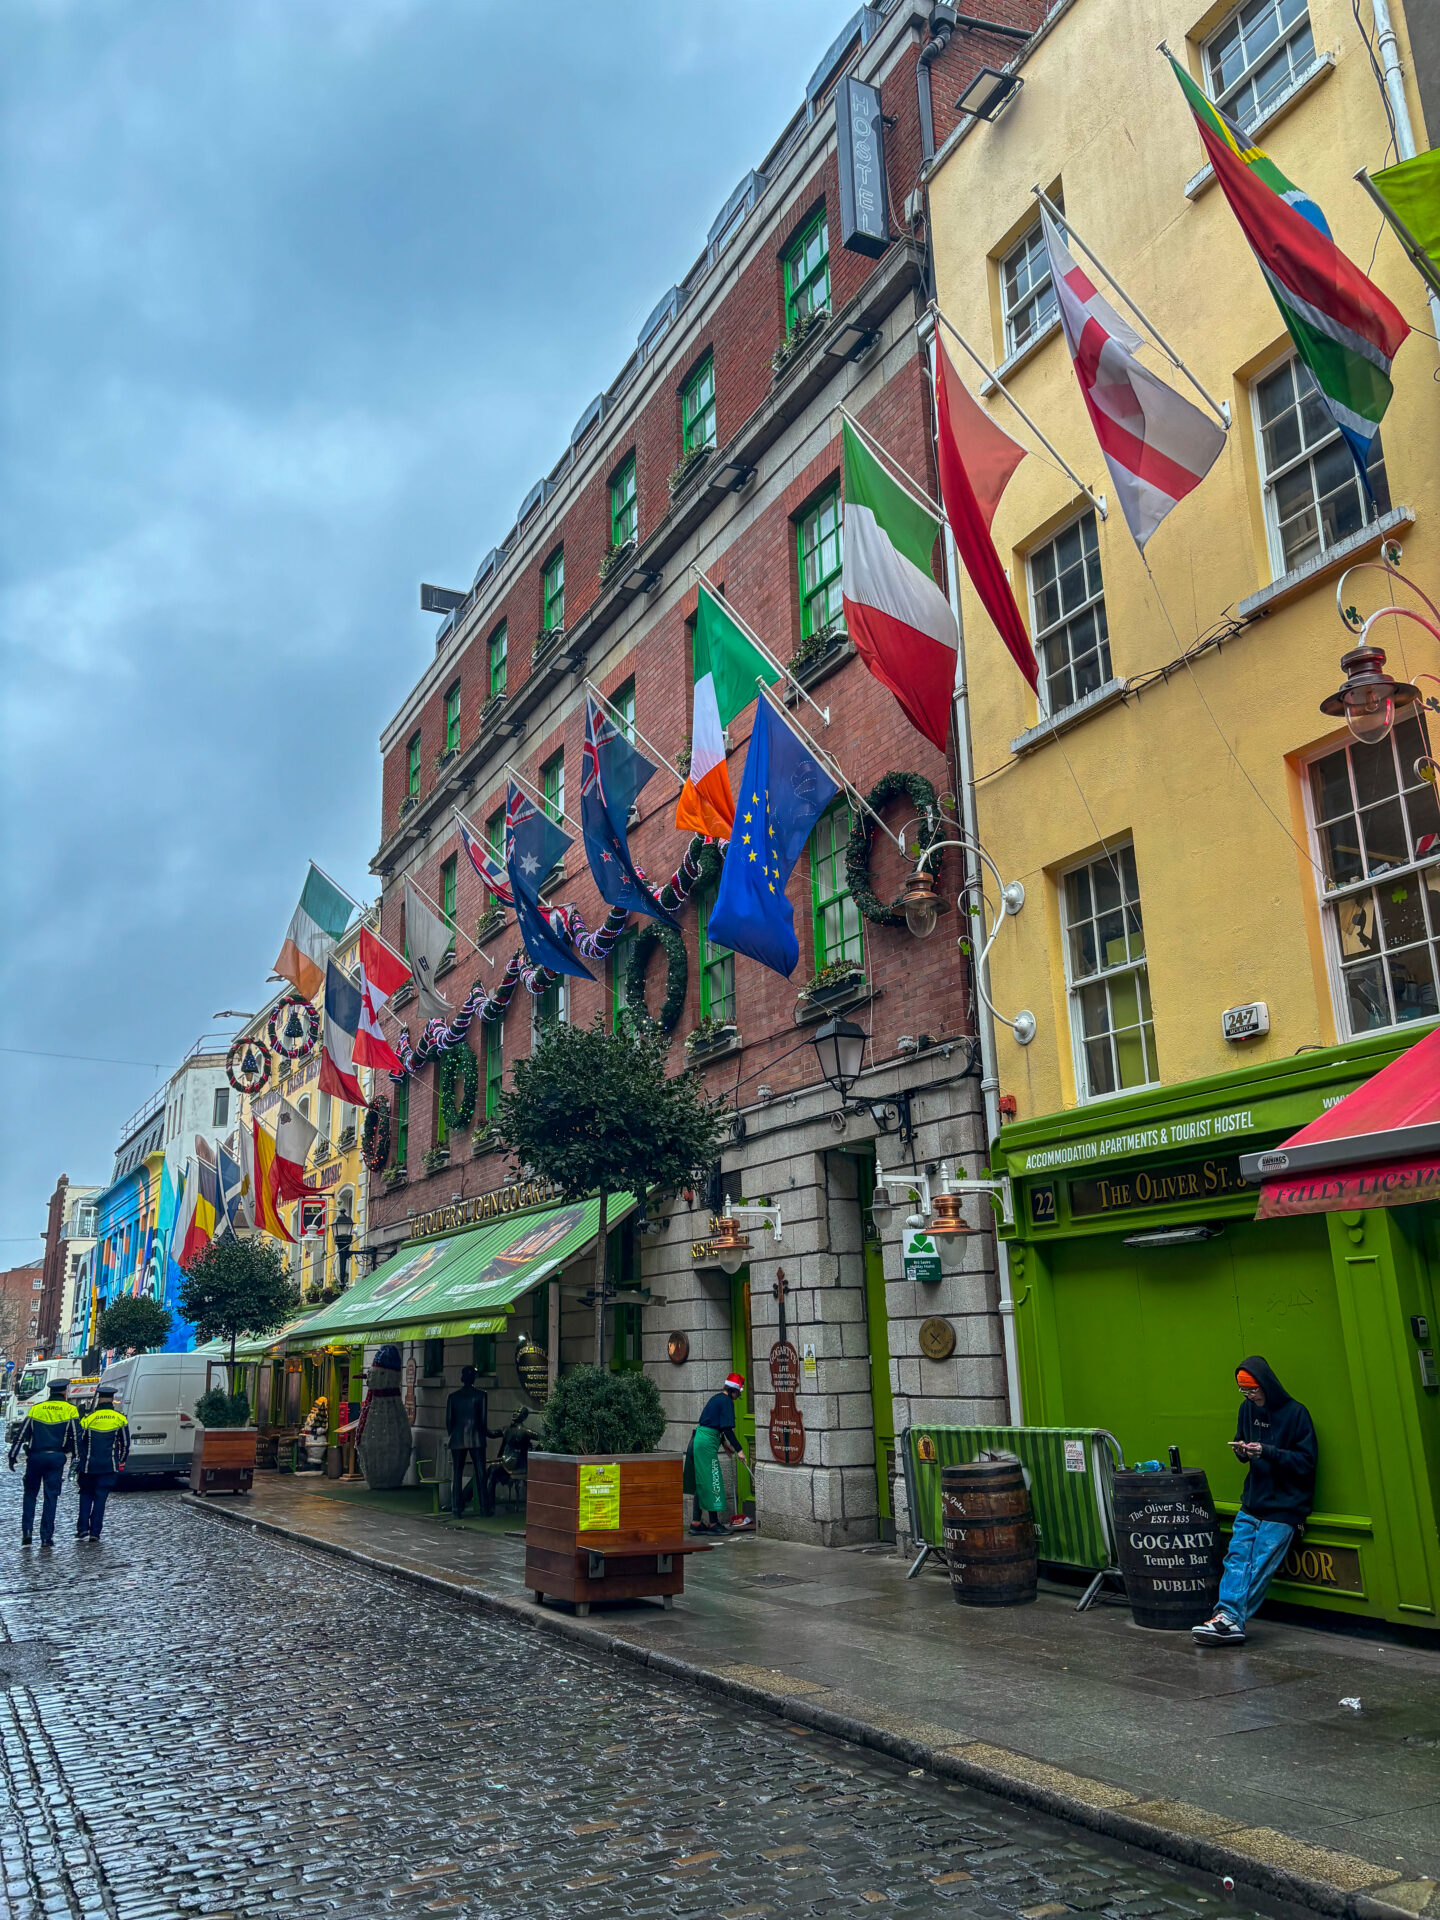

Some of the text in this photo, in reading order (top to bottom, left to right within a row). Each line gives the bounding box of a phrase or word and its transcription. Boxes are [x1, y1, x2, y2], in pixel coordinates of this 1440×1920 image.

[851, 92, 876, 237] HOSTEL
[1026, 1141, 1097, 1170] ACCOMMODATION
[1099, 1130, 1158, 1156] APARTMENTS
[1161, 1127, 1168, 1144] &
[1171, 1118, 1212, 1142] TOURIST
[1214, 1110, 1254, 1134] HOSTEL
[1097, 1180, 1132, 1208] THE
[1136, 1172, 1200, 1201] OLIVER
[1203, 1160, 1233, 1190] ST.
[410, 1216, 424, 1239] THE
[425, 1206, 456, 1234] OLIVER
[471, 1191, 499, 1222] JOHN
[1035, 1192, 1055, 1216] 22
[1128, 1502, 1209, 1522] The Oliver St. John
[1150, 1515, 1190, 1524] EST. 1835
[943, 1527, 968, 1541] ARTY
[1129, 1532, 1214, 1550] GOGARTY
[1143, 1554, 1208, 1569] Temple Bar
[1277, 1550, 1336, 1581] OOR
[1152, 1579, 1206, 1592] DUBLIN
